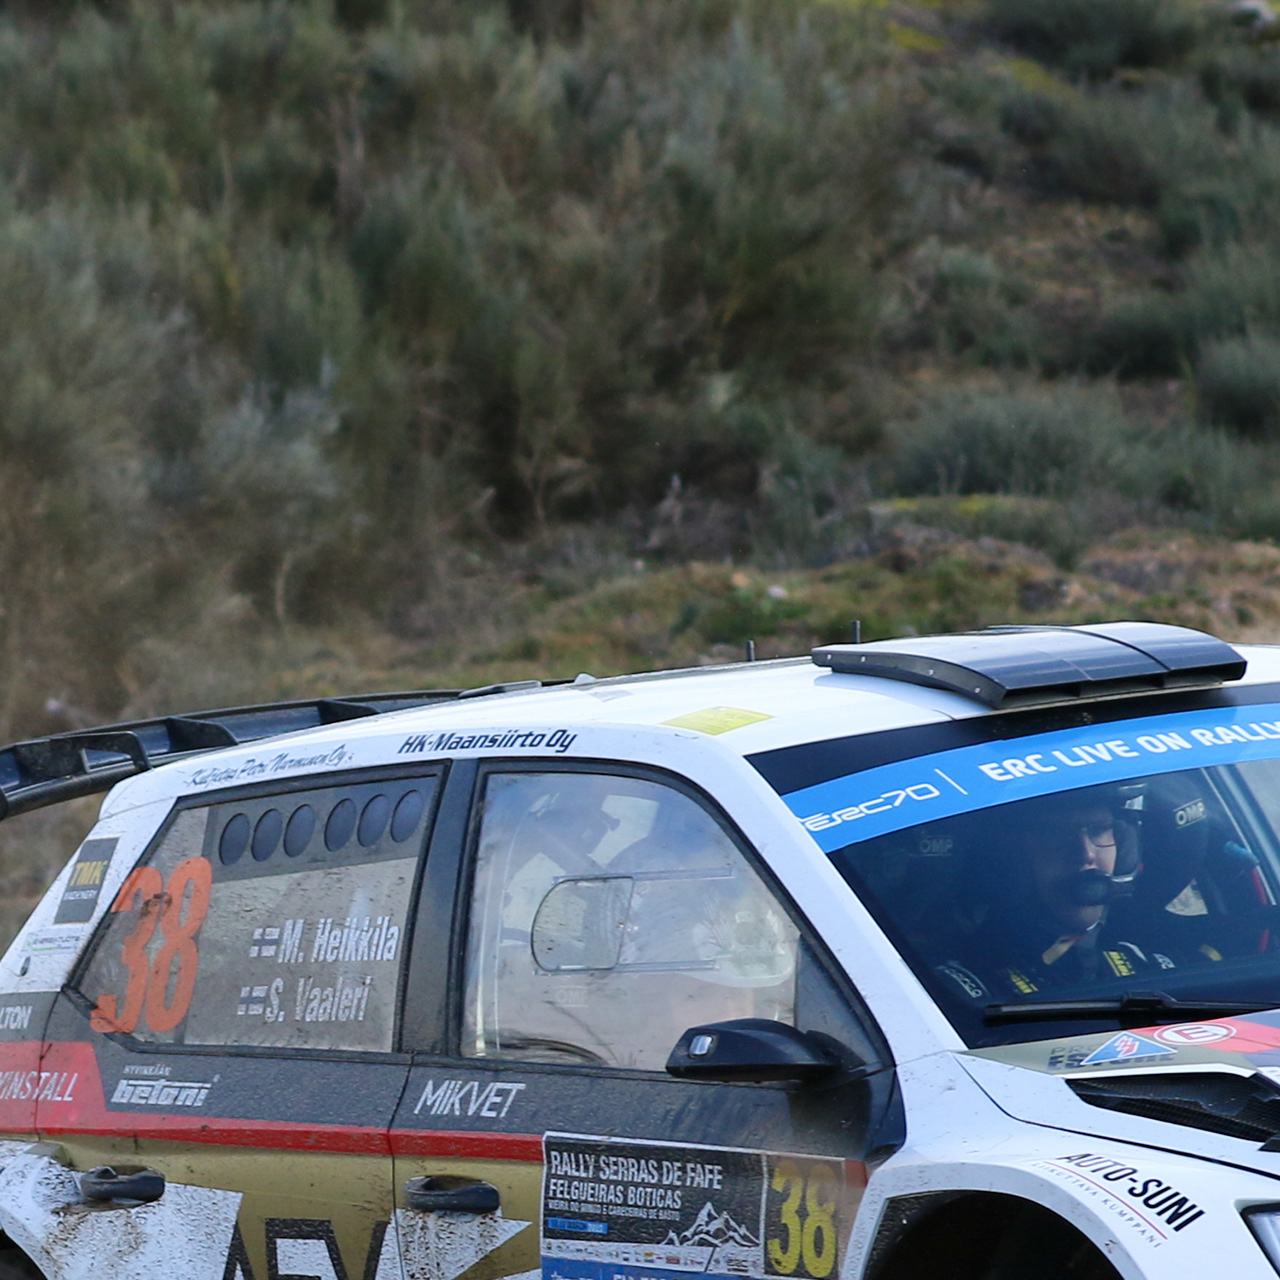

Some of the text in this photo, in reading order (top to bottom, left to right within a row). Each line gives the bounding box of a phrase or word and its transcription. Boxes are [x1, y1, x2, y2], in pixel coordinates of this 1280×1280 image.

[397, 729, 578, 754] HK-Maansiirto Oy
[977, 753, 1058, 782] ERC
[1051, 740, 1140, 767] LIVE
[1136, 731, 1186, 754] ON
[1175, 800, 1207, 826] OMP
[69, 860, 109, 887] TMK
[90, 857, 213, 1034] 38
[277, 919, 305, 964] M.
[264, 975, 373, 1023] S. Vaaleri
[110, 1079, 212, 1107] betoni
[413, 1079, 526, 1118] MIKVET
[550, 1150, 723, 1190] RALLY SERRAS DE FAFE
[548, 1178, 682, 1209] FELGUEIRAS BOTICAS
[1056, 1152, 1205, 1233] AUTO-SUNI
[768, 1160, 838, 1279] 38
[1101, 1198, 1163, 1249] KUMPPANI
